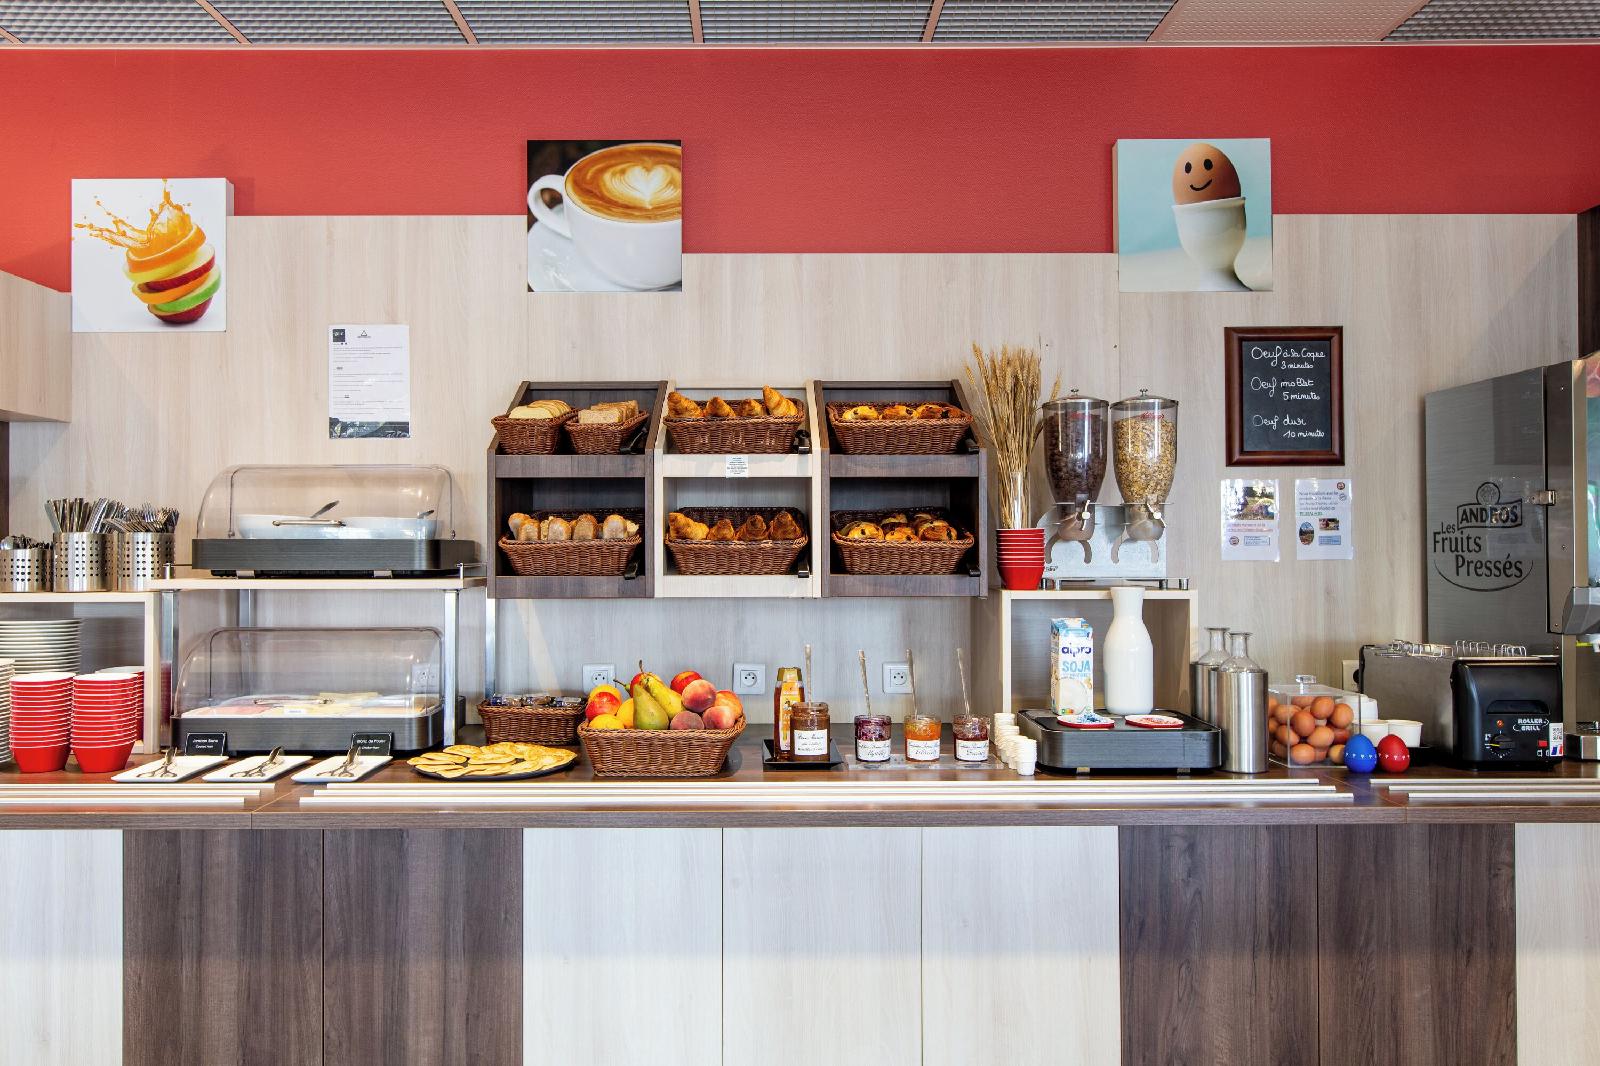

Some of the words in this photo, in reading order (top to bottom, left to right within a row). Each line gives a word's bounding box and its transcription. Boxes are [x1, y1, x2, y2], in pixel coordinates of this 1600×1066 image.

[1251, 345, 1282, 367] Oeuf
[1291, 348, 1300, 358] la
[1281, 360, 1287, 369] 3
[1287, 361, 1314, 369] minutes
[1251, 376, 1277, 398] Oeuf
[1283, 392, 1290, 401] 5
[1290, 391, 1320, 401] minutes
[1252, 414, 1279, 431] Oeuf
[1283, 413, 1307, 426] dur
[1283, 430, 1296, 439] 10
[1297, 428, 1325, 438] minutes
[1460, 505, 1519, 524] ANDROS
[1441, 521, 1456, 534] Les
[1433, 531, 1482, 553] Fruits
[1455, 553, 1523, 578] Pressés
[1062, 660, 1091, 672] SOJA
